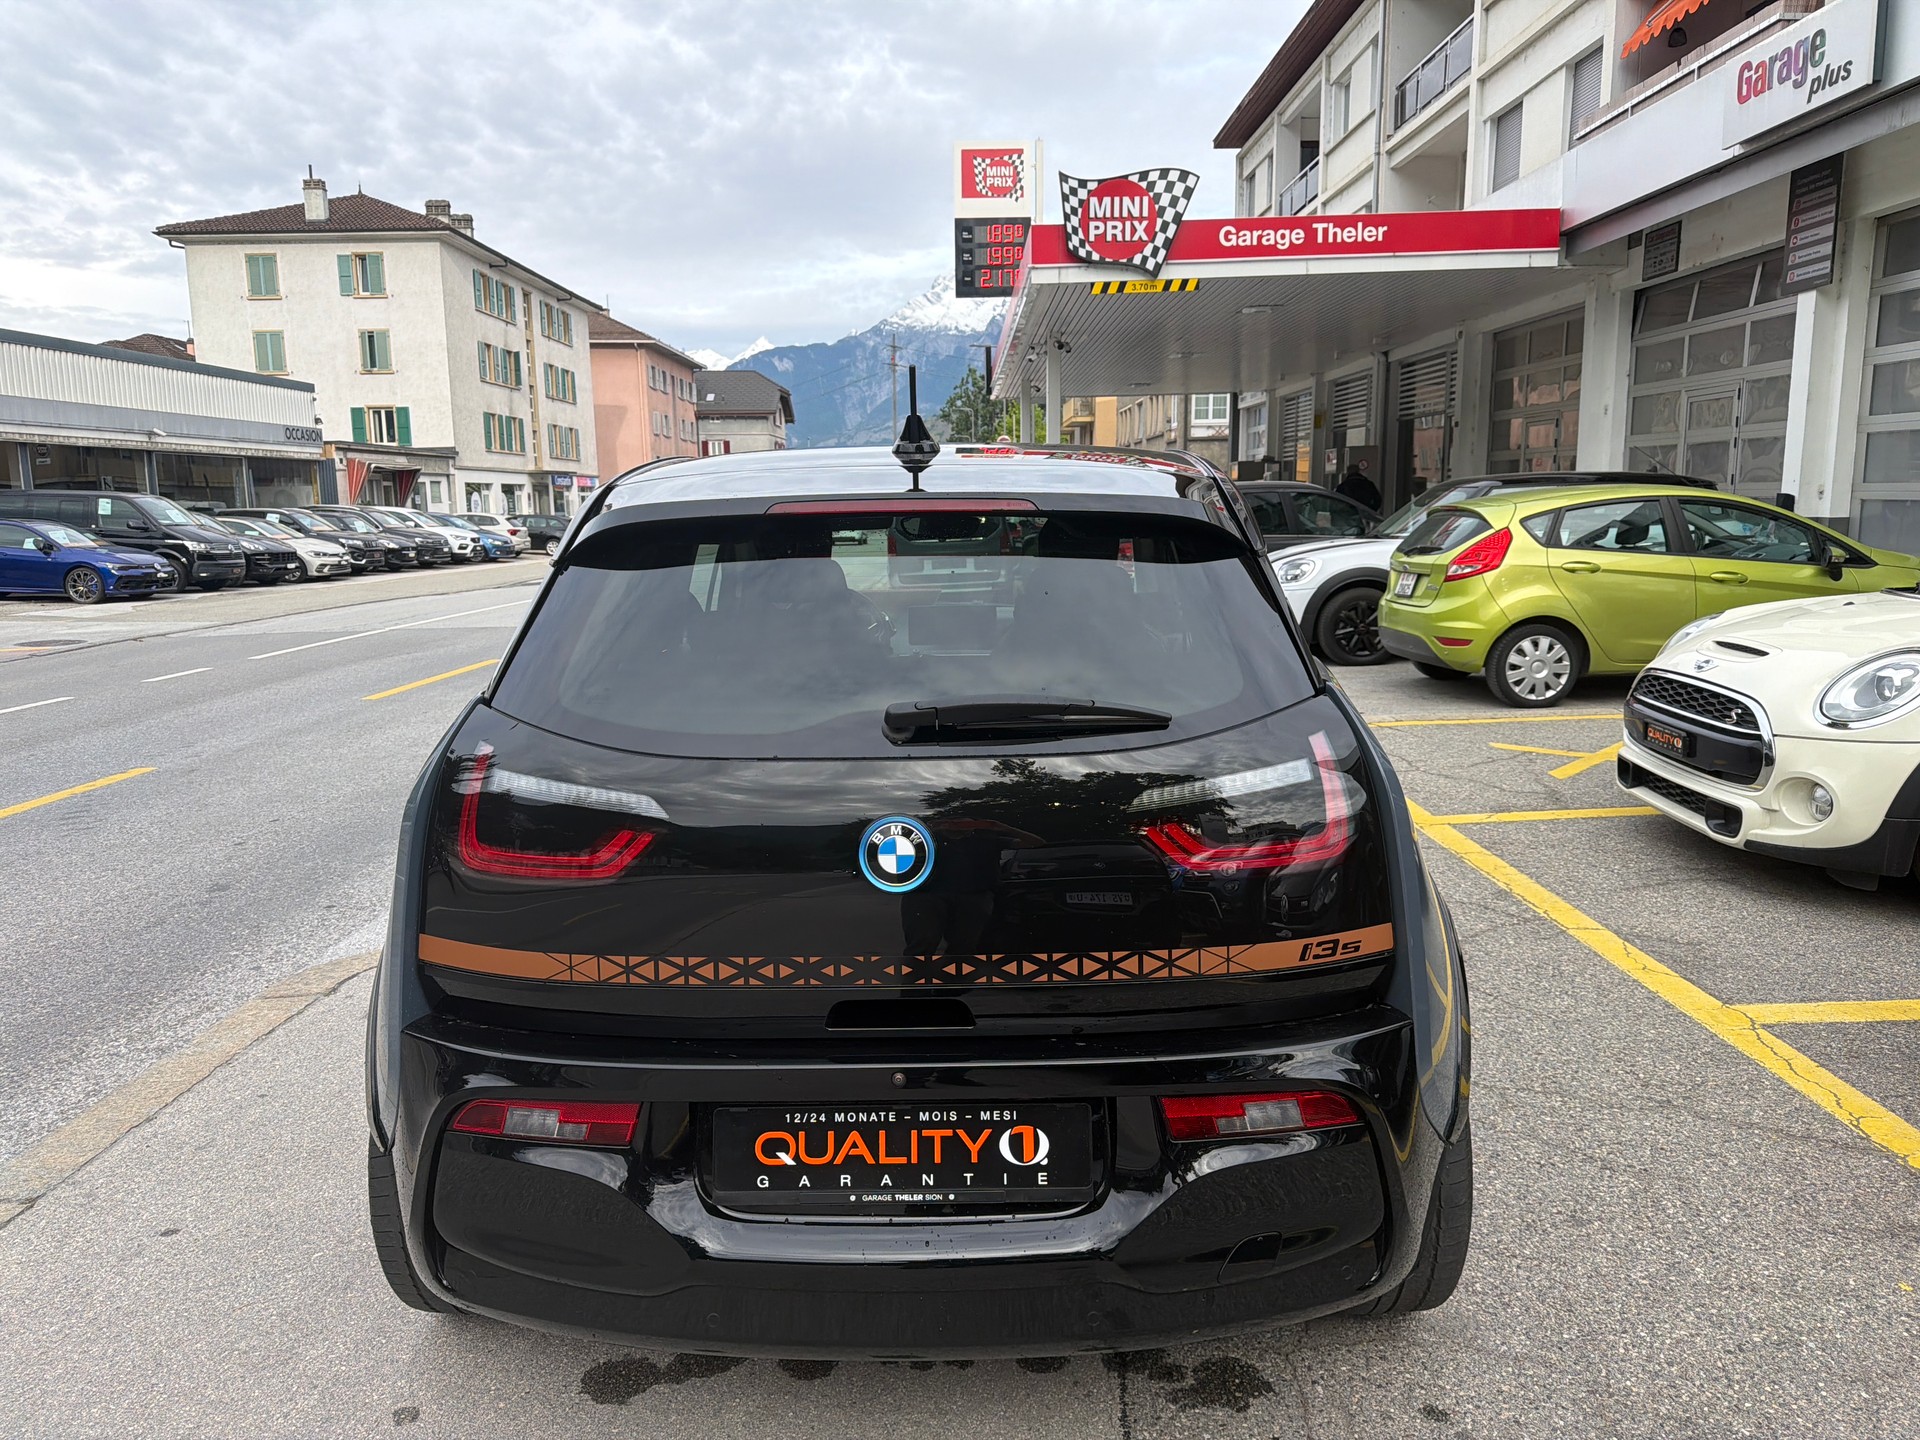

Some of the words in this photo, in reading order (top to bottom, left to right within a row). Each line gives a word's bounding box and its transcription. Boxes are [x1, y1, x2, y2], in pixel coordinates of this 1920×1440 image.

[1737, 28, 1827, 105] Garage
[1806, 60, 1853, 105] plus
[986, 166, 1014, 177] MINI
[986, 177, 1014, 188] PRIX
[1088, 196, 1149, 218] MINI
[1088, 220, 1149, 242] PRIX
[1219, 226, 1305, 250] Garage
[1312, 222, 1388, 244] Theler
[285, 427, 322, 442] OCCASION
[1647, 727, 1674, 745] QUALITY
[871, 825, 923, 846] BMW
[1299, 939, 1362, 962] i3s
[785, 1112, 826, 1123] 12/24
[835, 1111, 896, 1122] MONATE
[919, 1111, 957, 1121] MOIS
[980, 1110, 1017, 1121] MESI
[755, 1129, 993, 1167] QUALITY
[757, 1172, 1049, 1188] GARANTIE
[862, 1194, 893, 1202] GARAGE
[895, 1193, 924, 1202] THELER
[925, 1193, 943, 1202] SION
